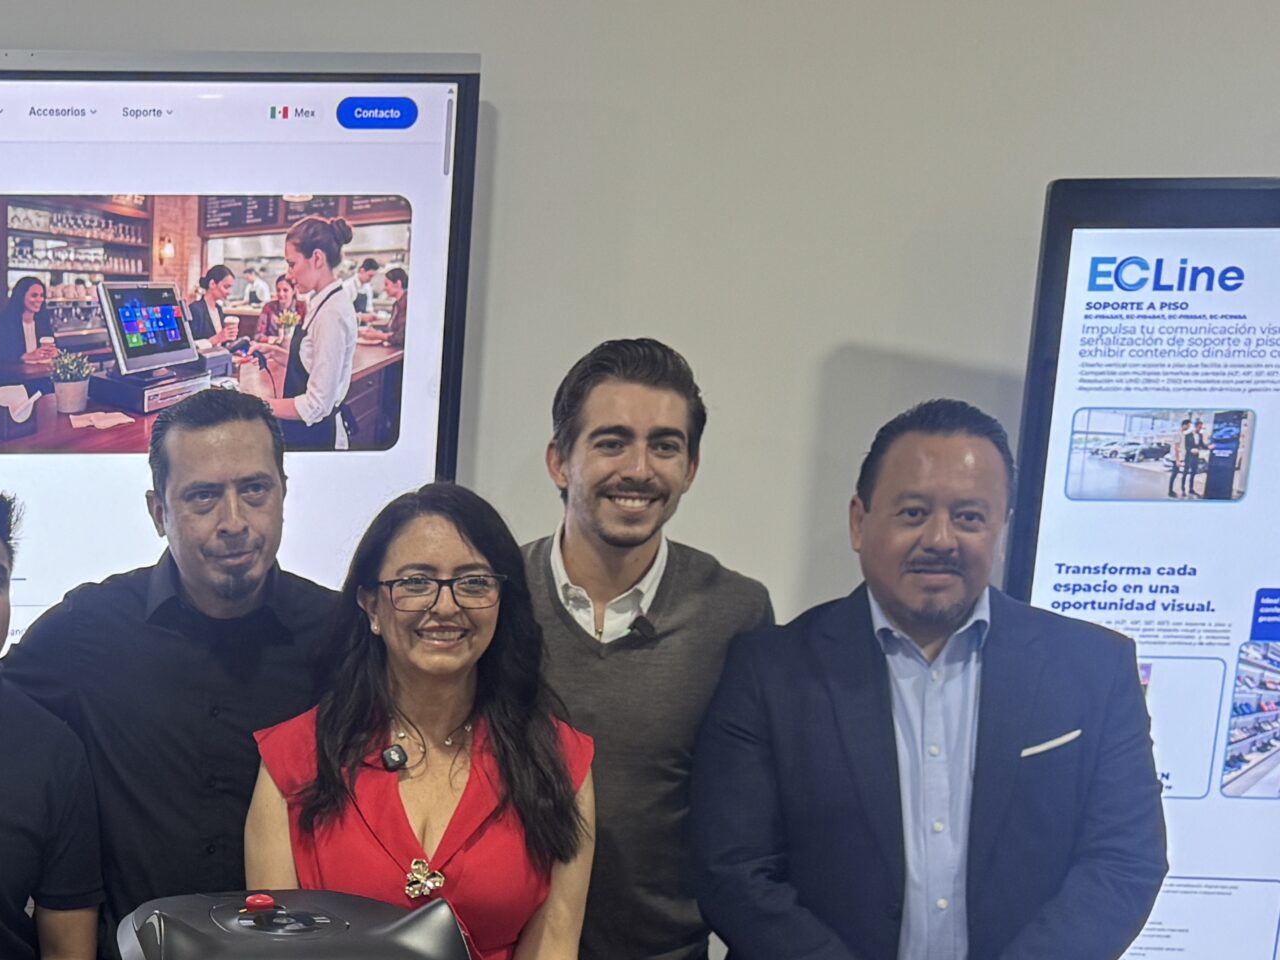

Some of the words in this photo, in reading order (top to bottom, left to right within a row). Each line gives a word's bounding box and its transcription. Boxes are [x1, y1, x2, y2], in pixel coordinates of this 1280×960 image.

[28, 105, 87, 118] Accesorios
[122, 106, 163, 121] Soporte
[294, 107, 316, 118] Mex
[354, 107, 401, 119] Contacto
[1087, 256, 1245, 292] ECLine
[1085, 301, 1145, 311] SOPORTE
[1146, 301, 1157, 311] A
[1159, 301, 1190, 311] PISO
[1081, 323, 1138, 338] Impulsa
[1140, 324, 1155, 335] tu
[1158, 322, 1257, 336] comunicación
[1079, 335, 1164, 347] señalización
[1166, 335, 1185, 347] de
[1187, 336, 1242, 349] soporte
[1243, 337, 1252, 347] a
[1078, 347, 1127, 359] exhibir
[1128, 347, 1199, 359] contenido
[1201, 346, 1267, 359] dinámico
[1054, 562, 1152, 577] Transforma
[1156, 563, 1198, 577] cada
[1052, 579, 1118, 596] espacio
[1122, 582, 1144, 594] en
[1148, 583, 1180, 595] una
[1051, 597, 1156, 615] oportunidad
[1160, 598, 1216, 613] visual.
